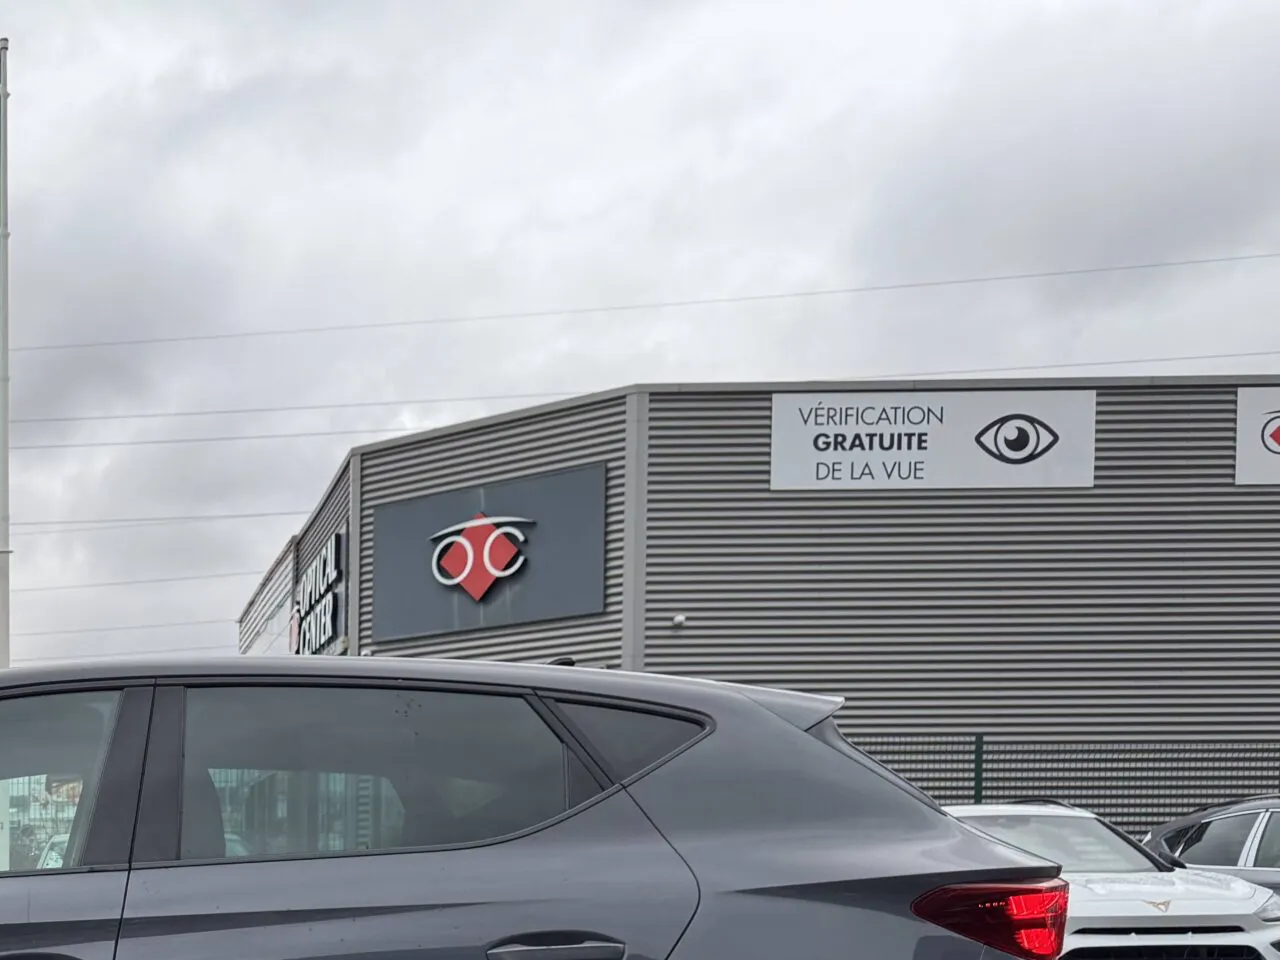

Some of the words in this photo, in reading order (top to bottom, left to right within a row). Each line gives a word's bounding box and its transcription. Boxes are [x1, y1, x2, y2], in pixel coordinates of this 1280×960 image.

[798, 401, 944, 426] VÉRIFICATION
[812, 432, 928, 451] GRATUITE
[816, 461, 842, 480] DE
[850, 461, 875, 480] LA
[882, 461, 925, 480] VUE
[300, 533, 338, 618] OPTICAL
